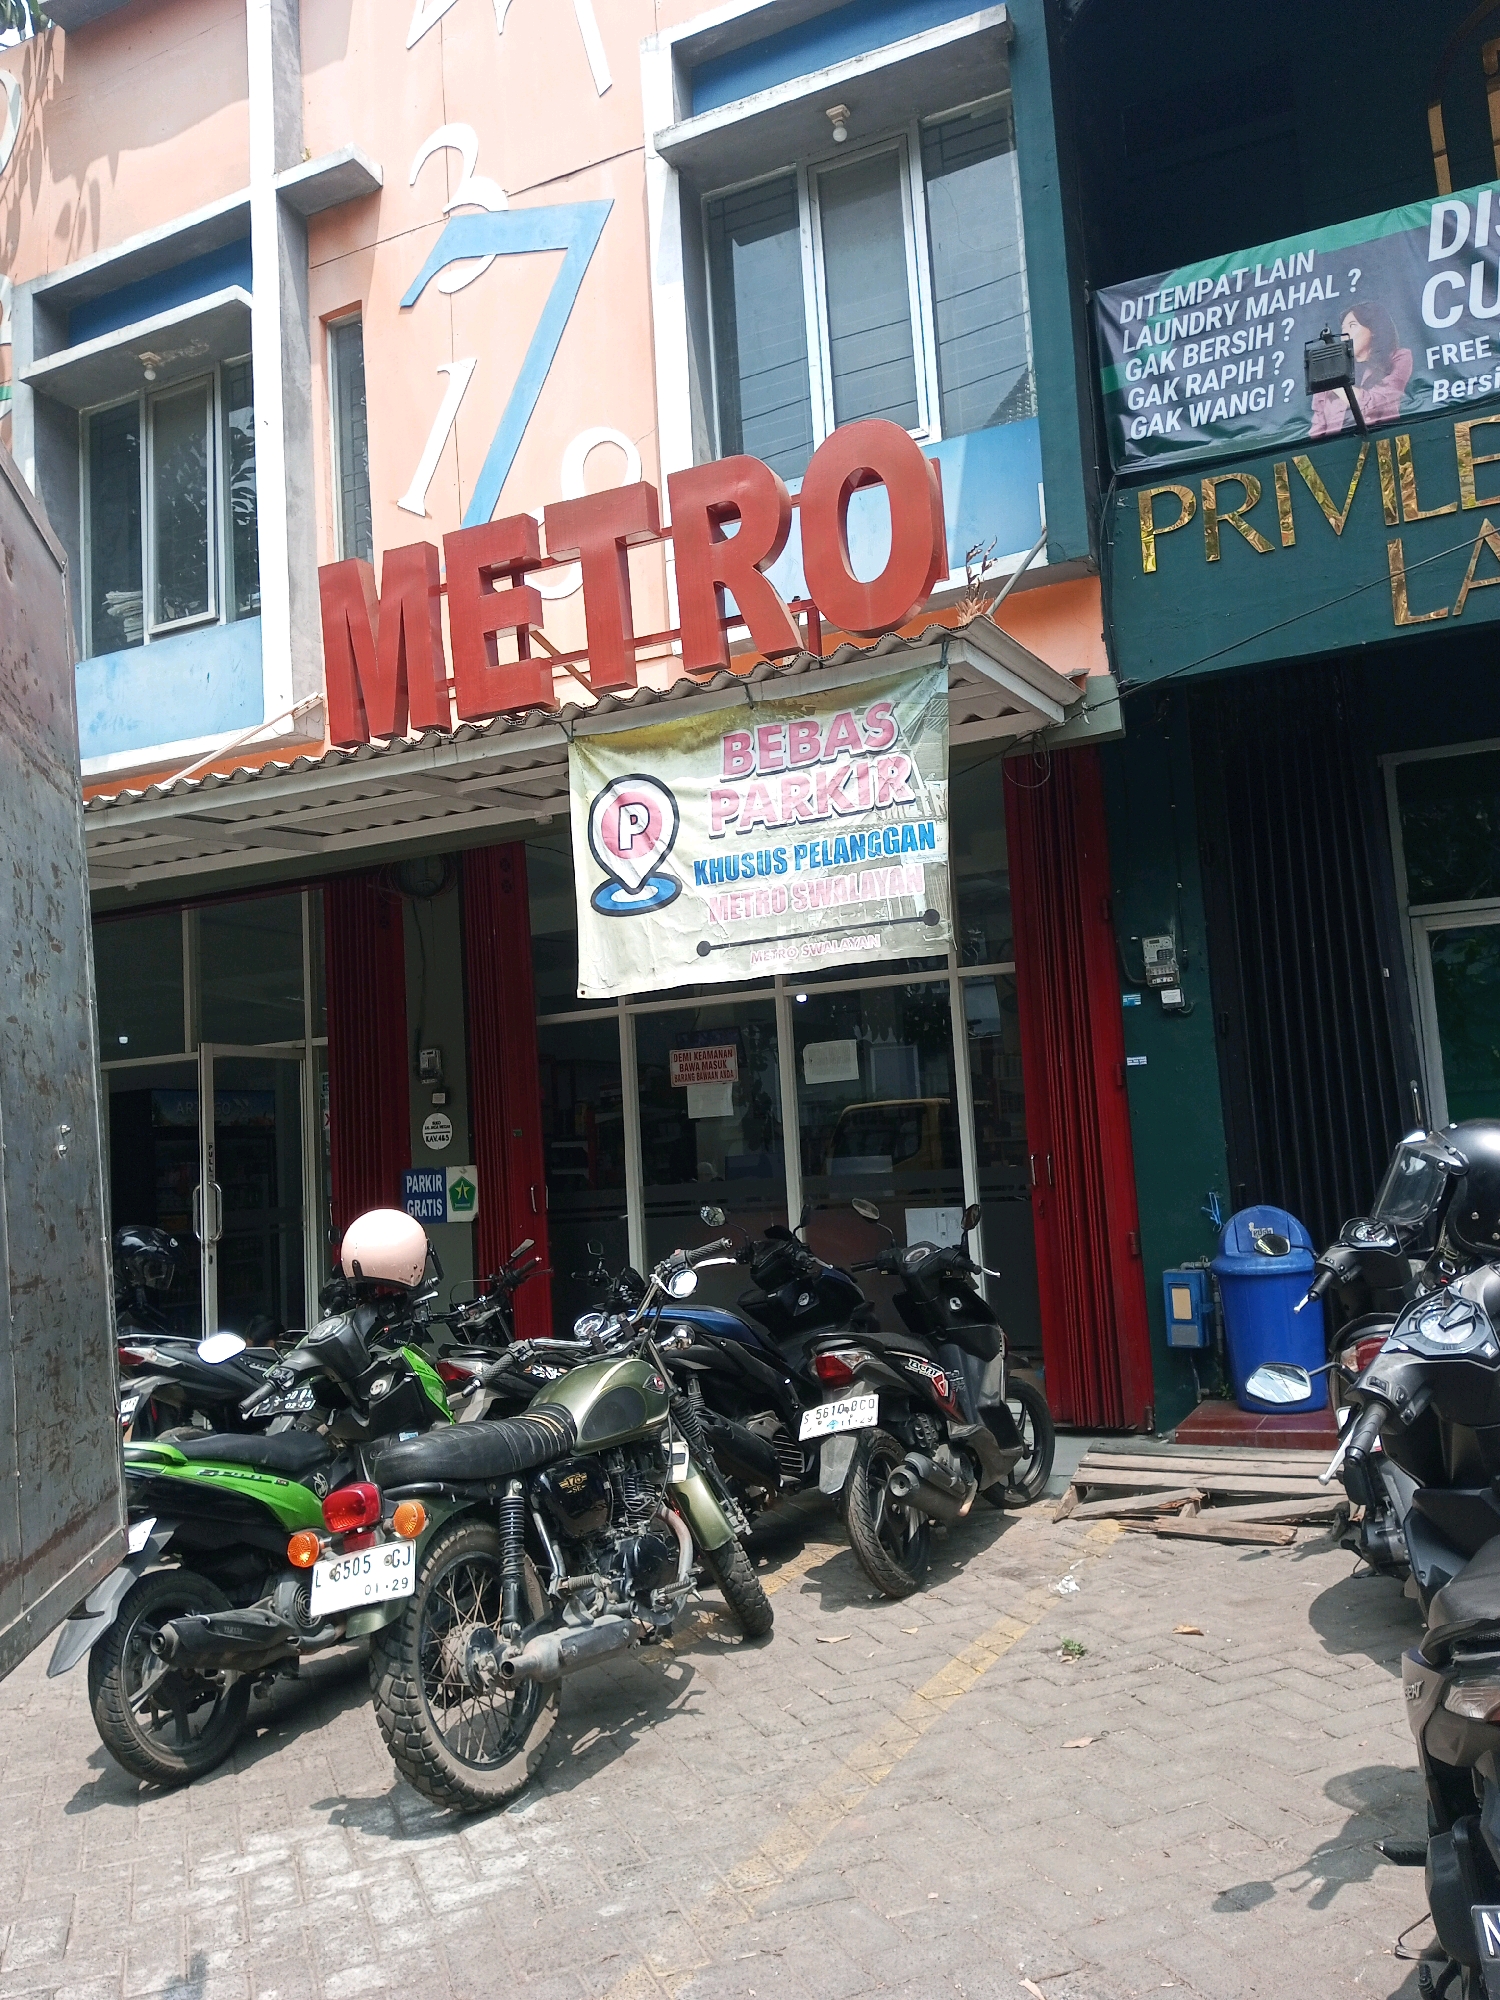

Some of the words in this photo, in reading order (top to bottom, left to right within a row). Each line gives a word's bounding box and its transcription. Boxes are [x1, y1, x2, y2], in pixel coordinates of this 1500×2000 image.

[1428, 189, 1500, 262] DI
[1119, 267, 1249, 325] DITEMPAT
[1254, 249, 1315, 288] LAIN
[1122, 299, 1240, 354] LAUNDRY
[1245, 274, 1340, 322] MAHAL
[1125, 348, 1178, 382] GAK
[1182, 321, 1275, 369] BERSIH
[1426, 335, 1492, 370] FREE
[1127, 377, 1180, 411] GAK
[1185, 356, 1265, 398] RAPIH
[1130, 407, 1184, 441] GAK
[1189, 384, 1275, 428] WANGI
[318, 418, 941, 747] METRO
[721, 702, 899, 780] BEBAS
[709, 756, 915, 837] PARKIR
[619, 802, 650, 851] P
[693, 848, 788, 886] KHUSUS
[794, 822, 936, 870] PELANGGAN
[708, 886, 788, 923] METRO
[792, 865, 925, 911] SWALAYAN
[751, 948, 797, 964] METRO
[801, 934, 881, 957] SWALAYAN
[673, 1052, 692, 1063] DEMI
[693, 1049, 733, 1061] KEAMANAN
[680, 1062, 700, 1073] BAWA
[702, 1060, 727, 1071] MASUK
[720, 1069, 734, 1078] ANDA
[406, 1174, 443, 1194] PARKIR
[407, 1198, 443, 1217] GRATIS
[315, 1569, 321, 1588] L
[333, 1554, 371, 1583] 6505
[392, 1546, 411, 1568] GJ
